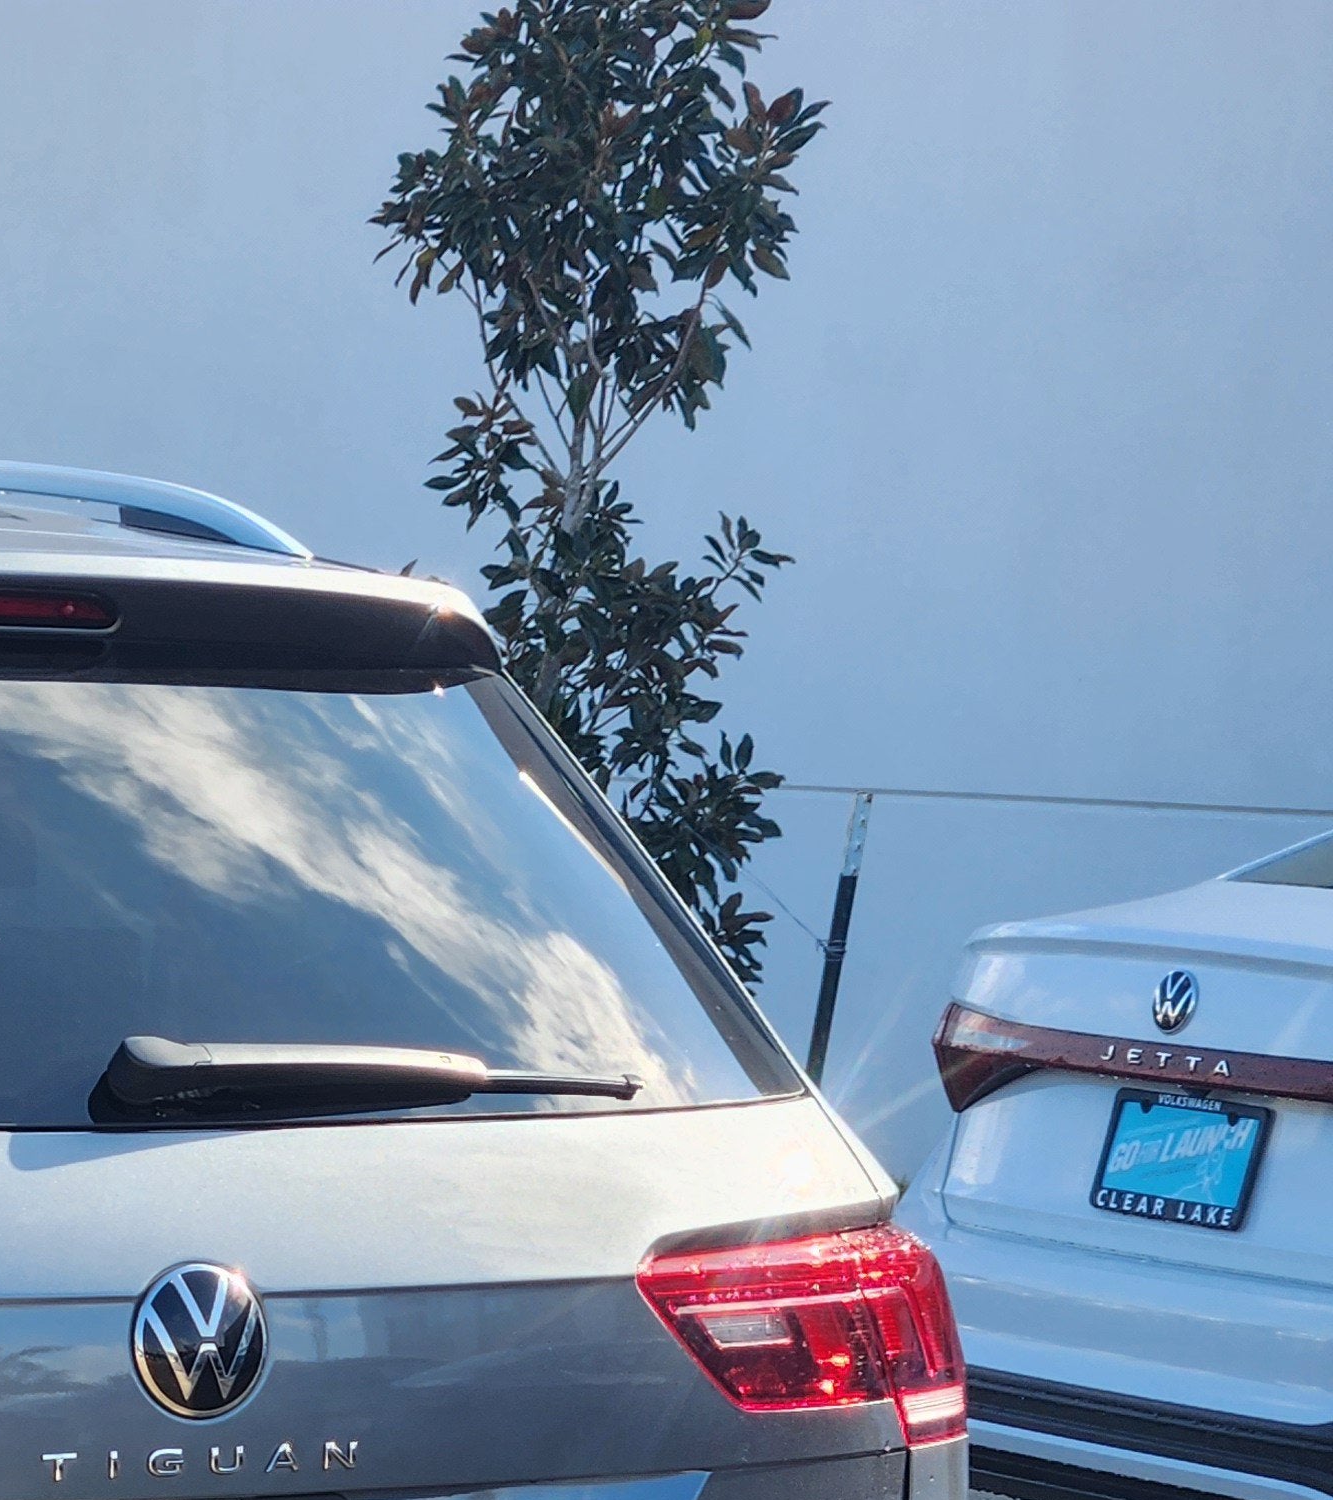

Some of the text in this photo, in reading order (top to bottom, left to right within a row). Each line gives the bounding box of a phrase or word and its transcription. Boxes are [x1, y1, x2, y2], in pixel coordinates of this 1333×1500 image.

[1100, 1045, 1230, 1077] JETTA
[1158, 1094, 1222, 1111] VOLKSWAGEN
[1096, 1189, 1233, 1226] CLEAR LAKE
[130, 1261, 269, 1419] VW
[41, 1440, 359, 1482] TIGUAN
